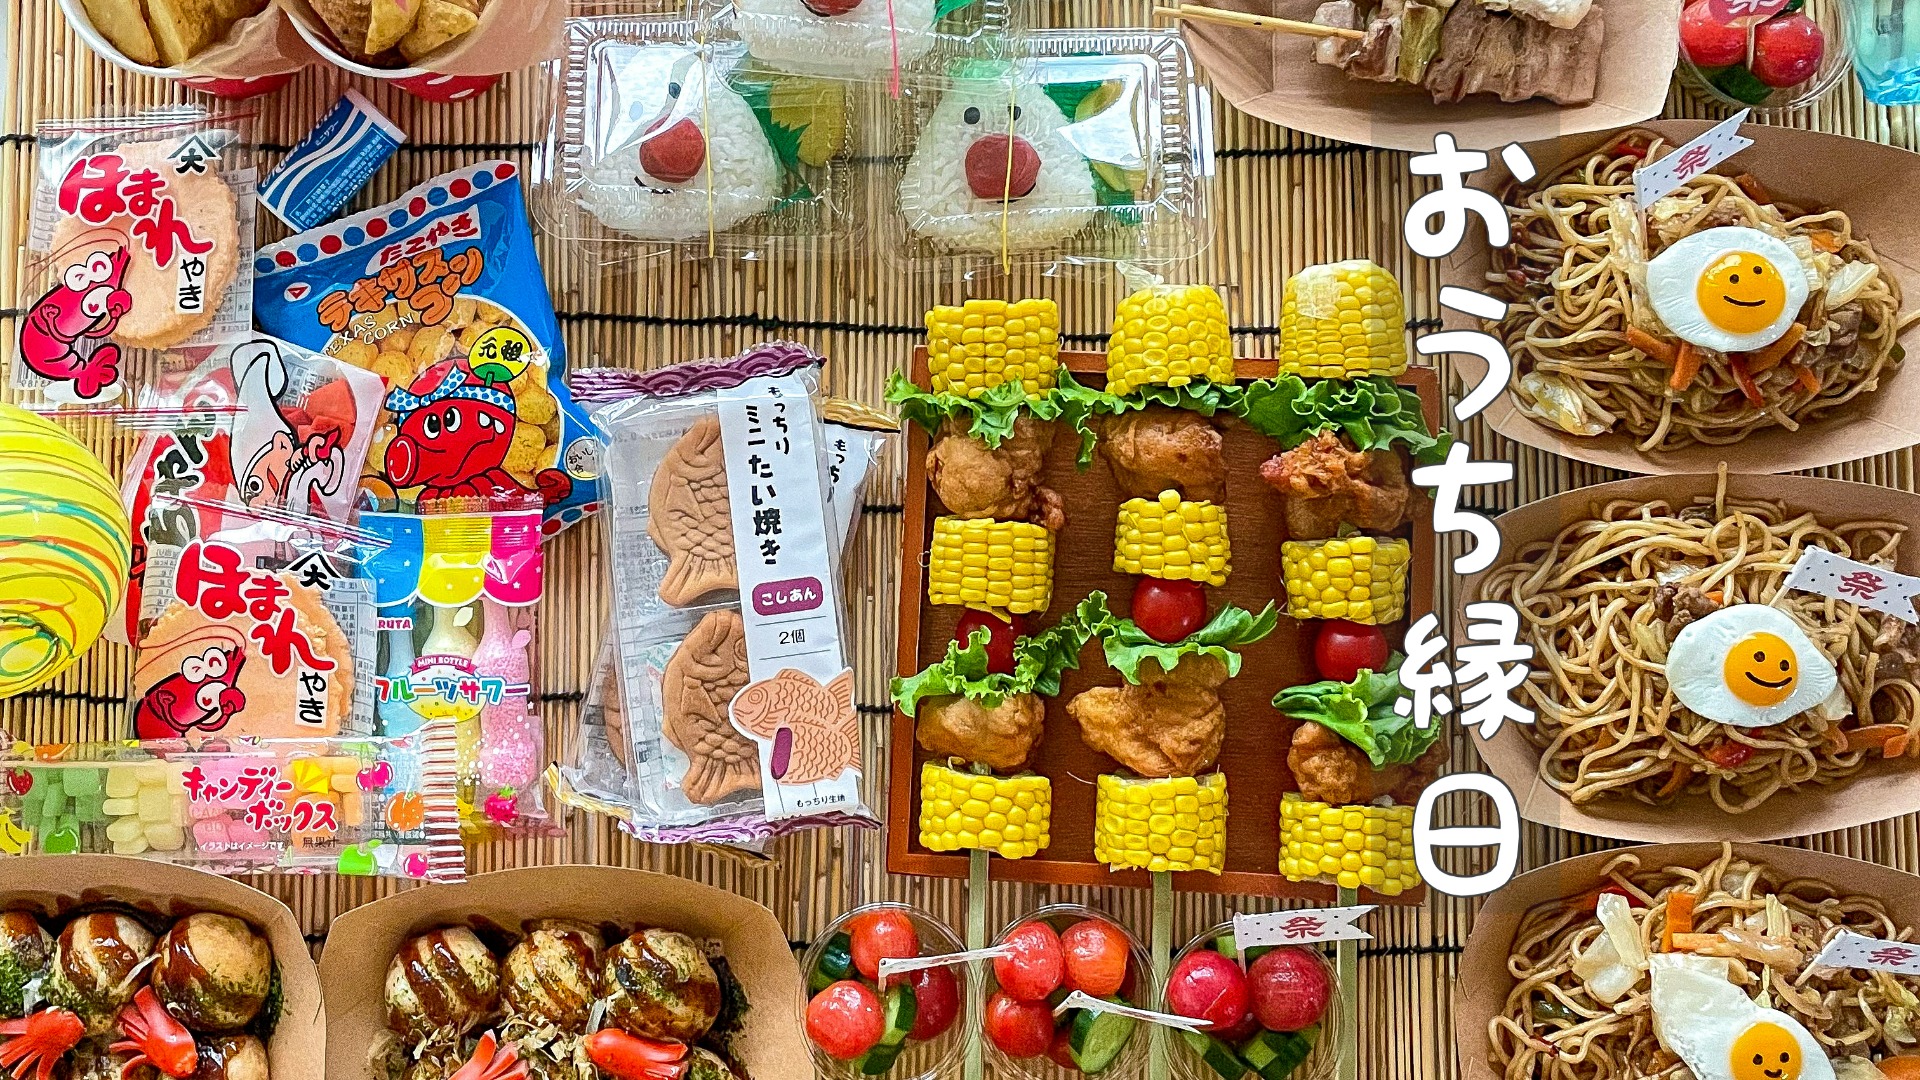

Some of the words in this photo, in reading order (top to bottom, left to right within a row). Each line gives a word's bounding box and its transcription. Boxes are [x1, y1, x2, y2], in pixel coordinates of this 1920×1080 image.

[1672, 143, 1713, 180] 祭
[58, 154, 214, 267] ほまれ
[379, 212, 479, 267] たこやき
[178, 256, 206, 310] やき
[363, 312, 414, 345] CORN
[767, 386, 790, 455] もっちり
[745, 404, 783, 566] ミニたい焼き
[760, 585, 817, 607] こしあん
[1837, 571, 1889, 601] 祭
[176, 541, 336, 676] ほまれ
[779, 627, 807, 645] 2個
[416, 656, 437, 668] MINI
[438, 655, 470, 668] BOTTLE
[298, 671, 327, 725] やき
[375, 677, 530, 704] フルーツサワー
[181, 765, 293, 803] キャンディー
[796, 794, 847, 808] もっちり生地
[244, 799, 339, 833] ボックス
[1278, 915, 1328, 939] 祭
[1866, 946, 1918, 967] 祭
